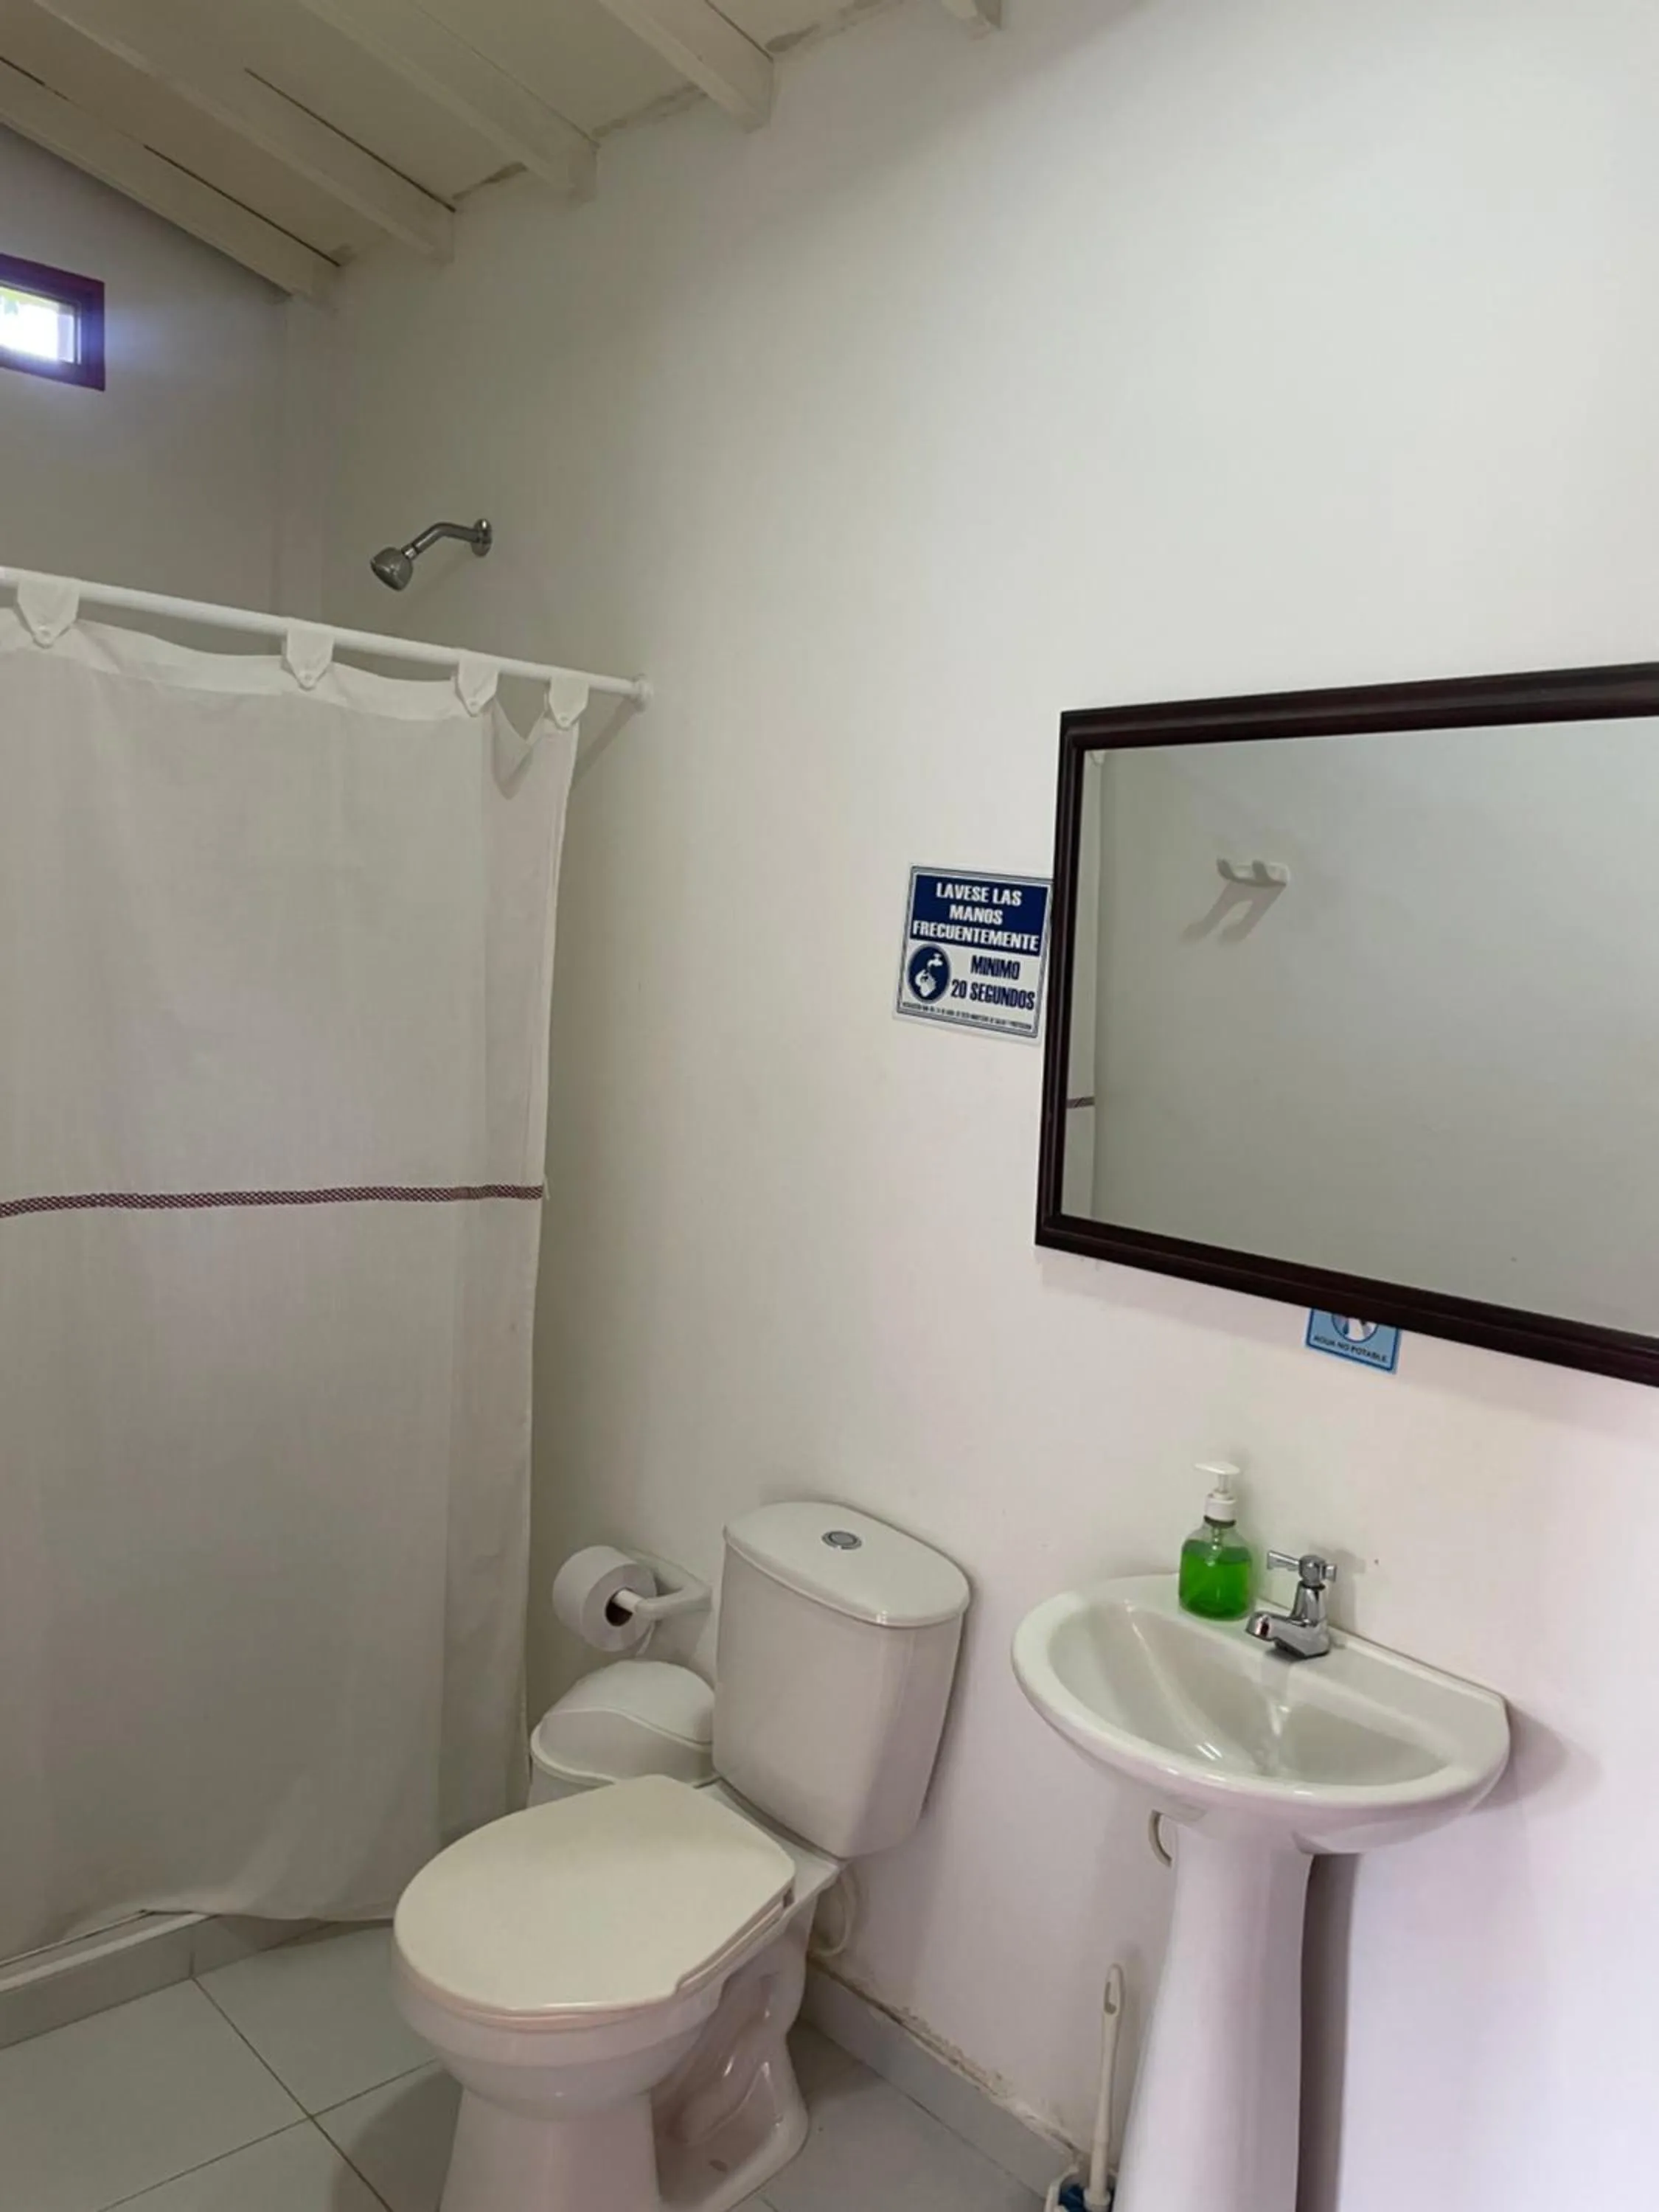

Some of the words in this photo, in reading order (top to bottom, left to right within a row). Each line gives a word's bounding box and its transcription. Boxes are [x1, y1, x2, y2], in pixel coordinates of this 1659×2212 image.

[936, 883, 989, 902] LAVESE
[992, 888, 1022, 906] LAS
[949, 905, 1003, 925] MANOS
[913, 920, 1039, 951] FRECUENTEMENTE
[970, 955, 1020, 980] MINIMO
[951, 979, 967, 998] 20
[970, 982, 1034, 1011] SEGUNDOS
[1338, 1341, 1349, 1351] NO
[1351, 1346, 1387, 1362] POTABLE
